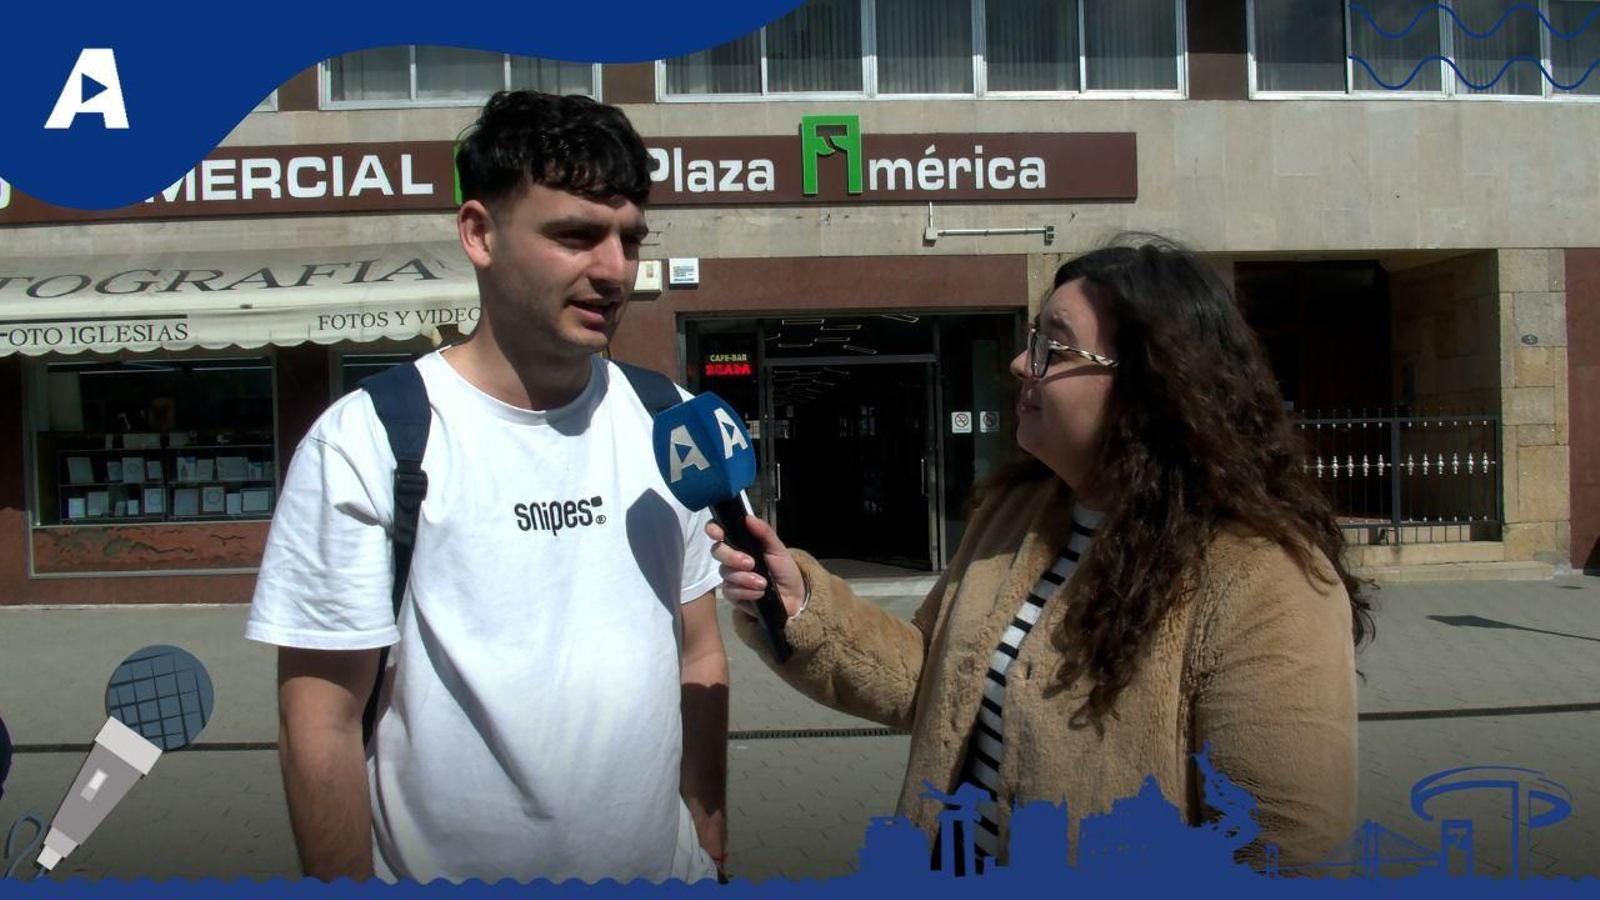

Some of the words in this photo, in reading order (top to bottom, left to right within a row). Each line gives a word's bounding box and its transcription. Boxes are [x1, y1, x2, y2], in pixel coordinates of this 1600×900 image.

[647, 147, 775, 193] Plaza
[319, 312, 389, 331] FOTOS
[395, 311, 411, 326] Y
[0, 328, 63, 346] OTO
[70, 323, 188, 345] IGLESIAS
